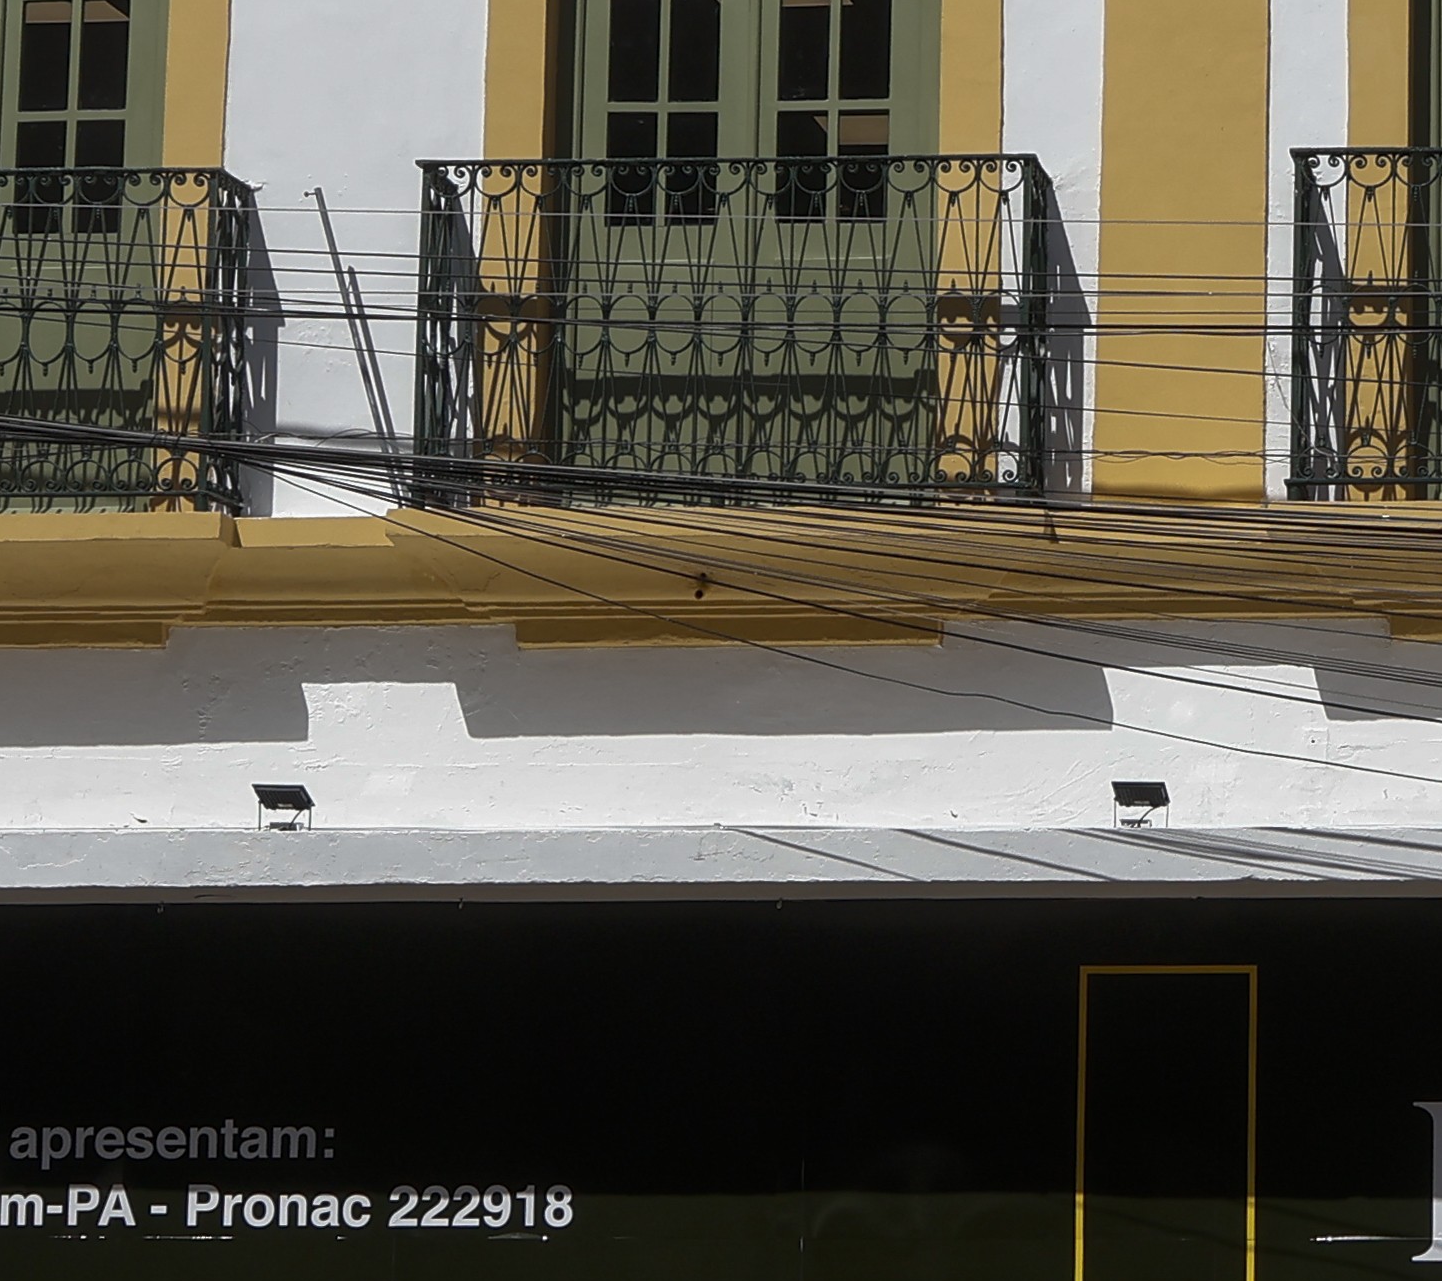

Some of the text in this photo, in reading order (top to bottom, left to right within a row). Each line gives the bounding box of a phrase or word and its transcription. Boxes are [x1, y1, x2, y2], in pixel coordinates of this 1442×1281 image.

[9, 1118, 335, 1171] apresentam:
[185, 1184, 372, 1229] Pronac
[387, 1184, 574, 1229] 222918
